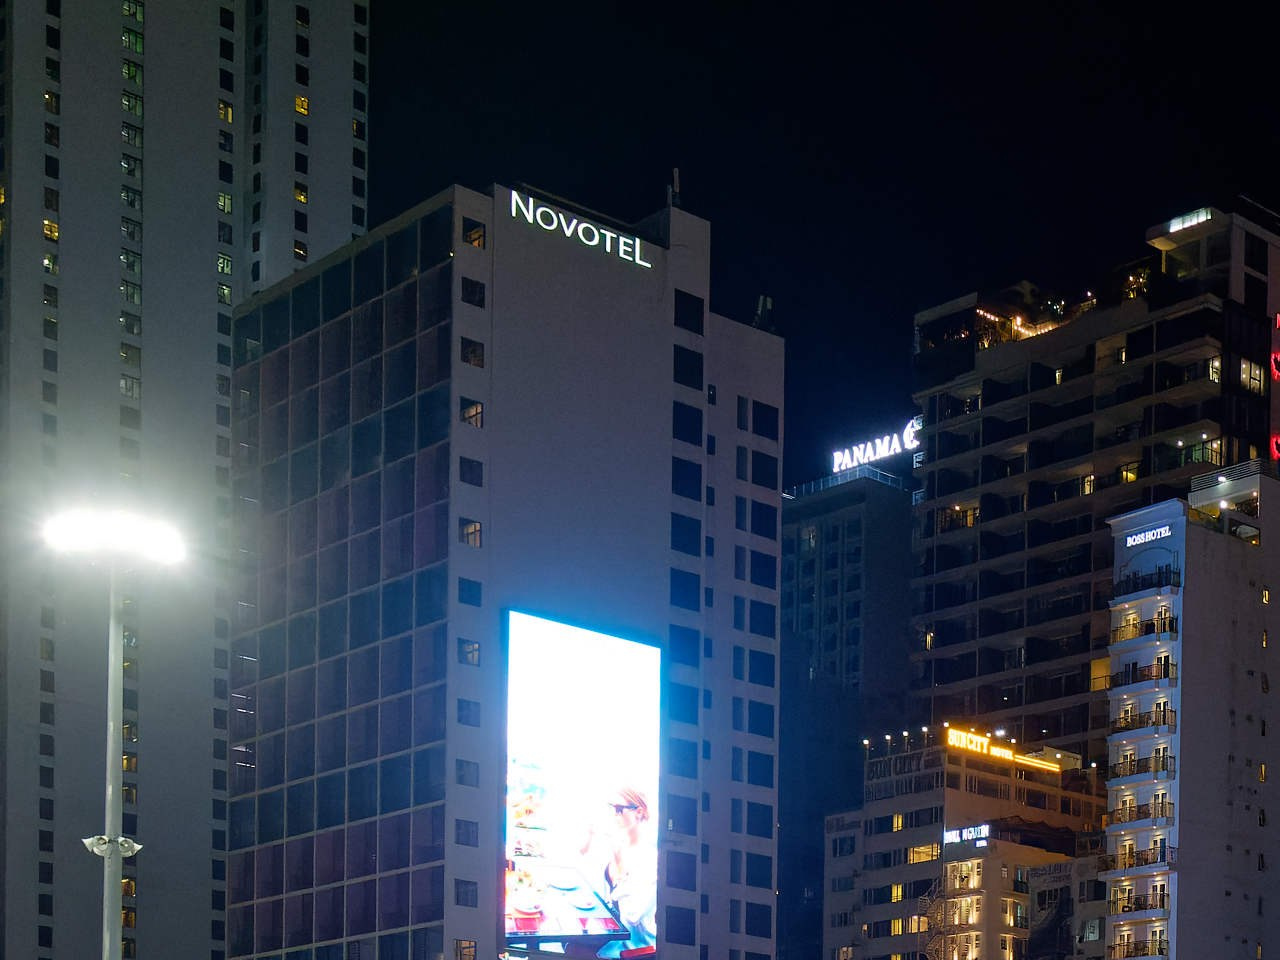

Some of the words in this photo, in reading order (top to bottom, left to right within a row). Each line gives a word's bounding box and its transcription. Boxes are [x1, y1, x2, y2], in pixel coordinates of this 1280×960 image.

[511, 190, 652, 268] NOVOTEL
[832, 433, 902, 473] PANAMA
[1126, 532, 1146, 547] BOSS
[1145, 525, 1171, 542] HOTEL
